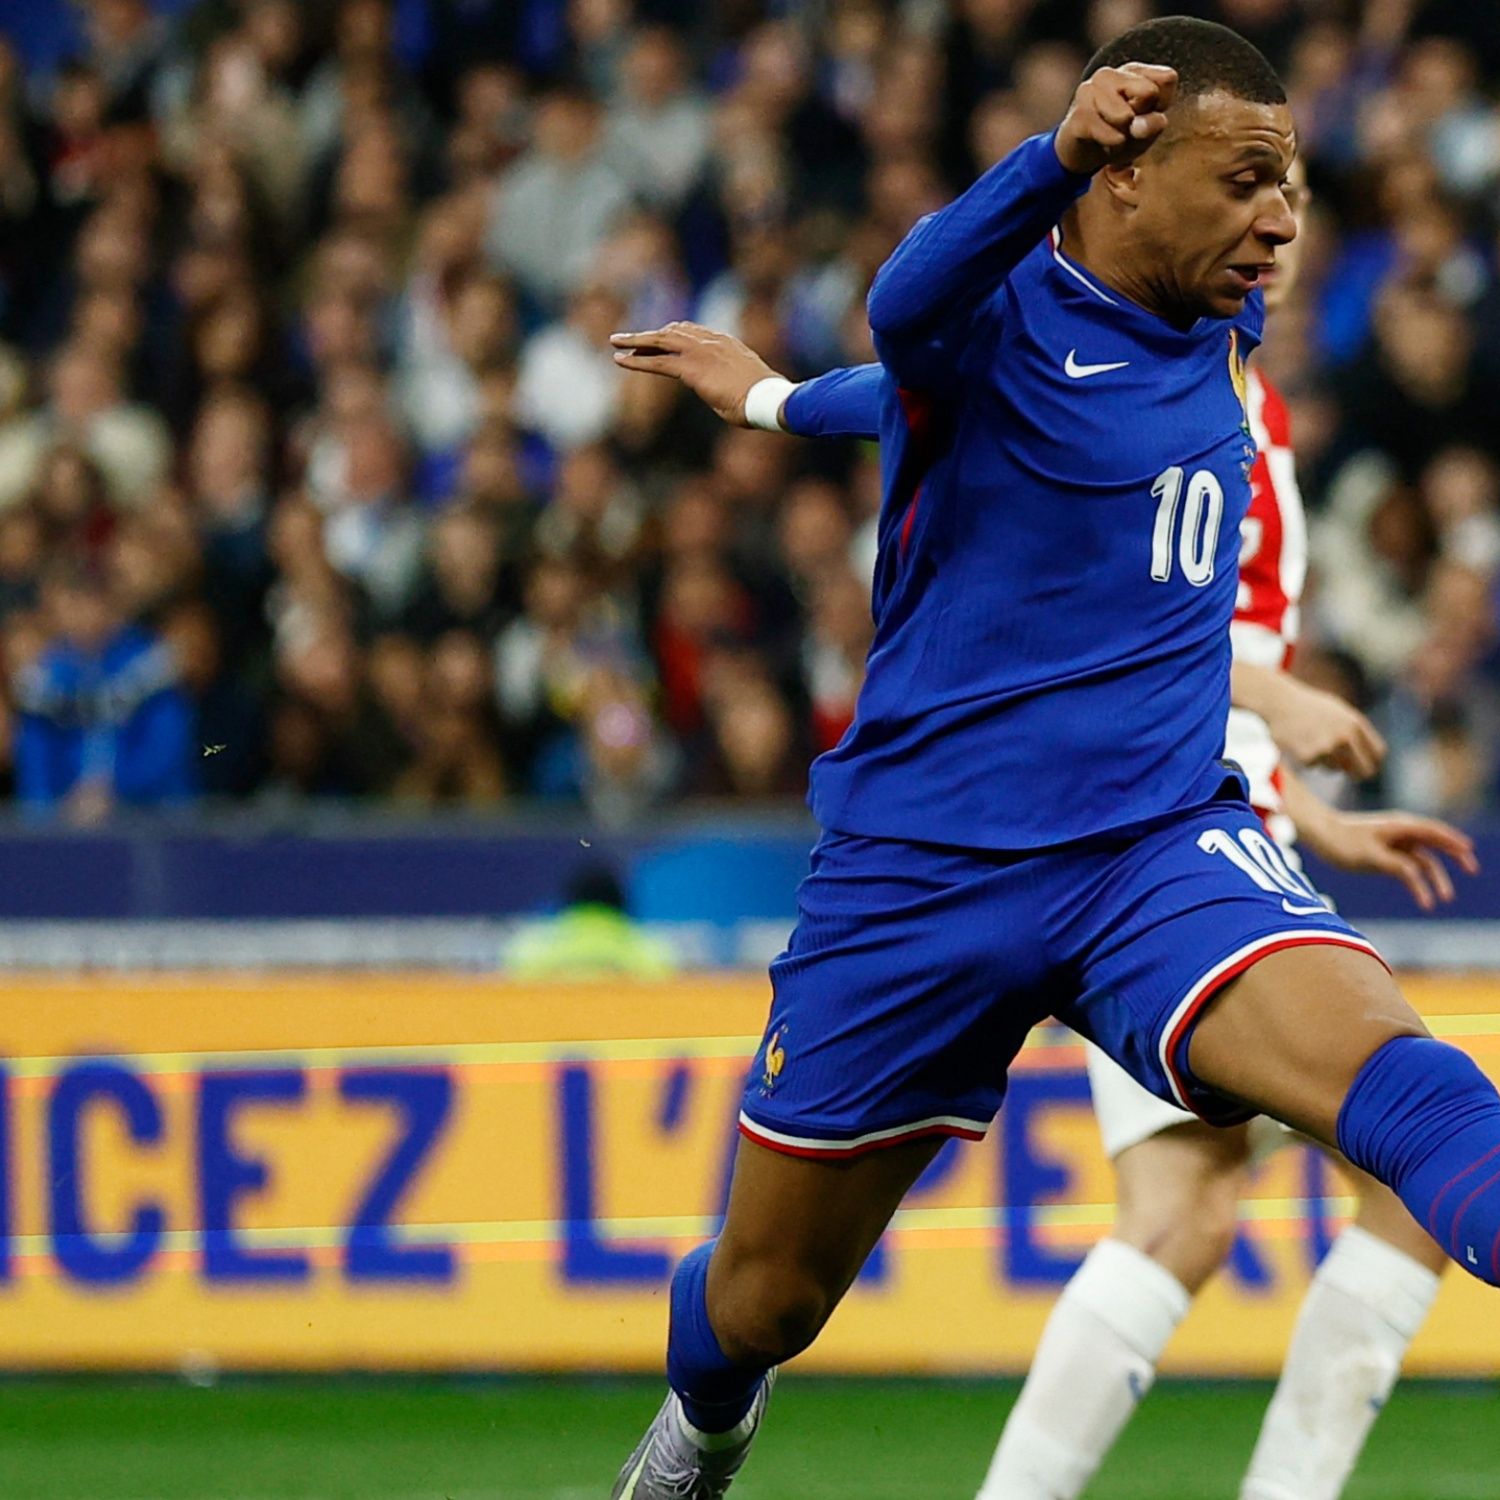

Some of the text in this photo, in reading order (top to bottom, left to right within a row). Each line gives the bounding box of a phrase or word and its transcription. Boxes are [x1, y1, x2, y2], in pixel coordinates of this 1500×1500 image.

[1150, 466, 1224, 587] 10
[1196, 828, 1315, 901] 10
[0, 1060, 456, 1284] CEZ
